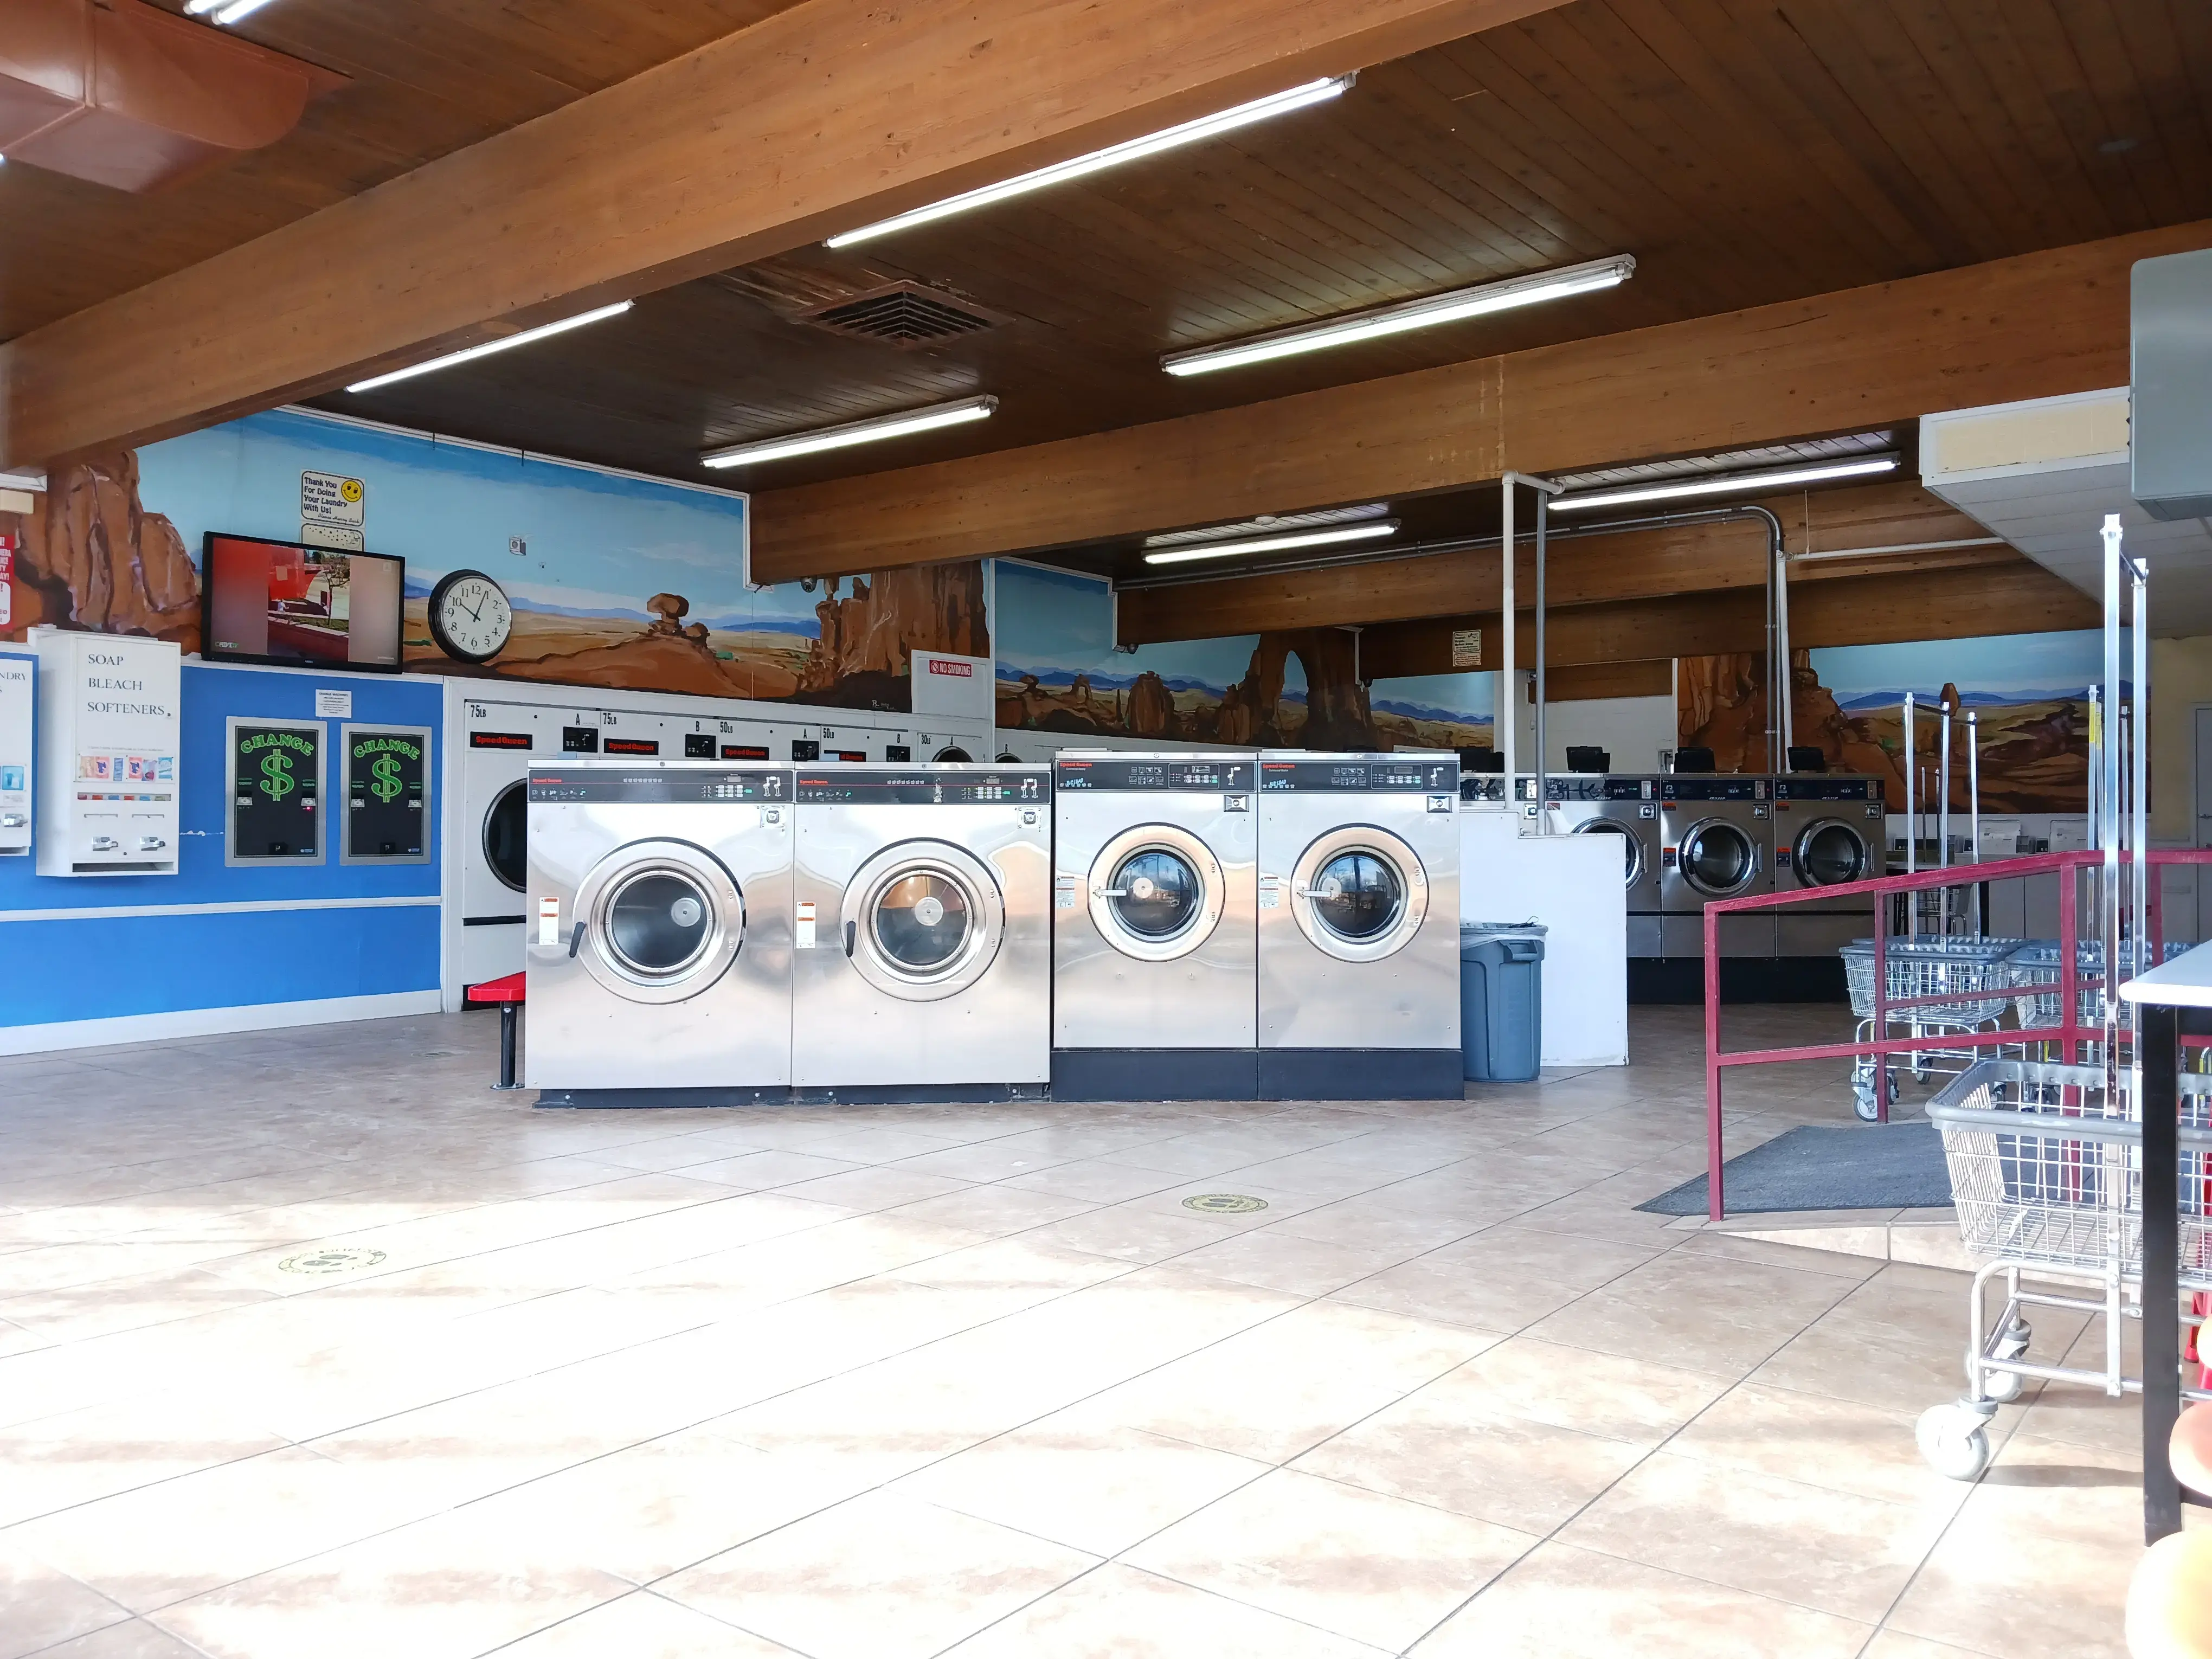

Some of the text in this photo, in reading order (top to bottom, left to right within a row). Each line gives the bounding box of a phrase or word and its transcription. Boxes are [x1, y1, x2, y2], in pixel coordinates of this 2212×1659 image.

[304, 477, 337, 488] Thank You
[317, 488, 336, 497] Doing
[304, 494, 347, 507] Your Laundry
[304, 503, 319, 512] With
[461, 587, 468, 597] 11
[472, 585, 481, 595] 12
[453, 597, 461, 607] 10
[493, 600, 498, 609] 2
[448, 608, 454, 618] 9
[497, 614, 502, 623] 3
[451, 622, 458, 631] 8
[492, 627, 498, 635] 4
[461, 633, 466, 642] 7
[471, 637, 478, 647] 6
[484, 635, 490, 645] 5
[88, 654, 124, 665] SOAP
[940, 663, 970, 675] NO SMOKING
[89, 678, 142, 690] BLEACH
[471, 705, 486, 717] 75LB
[576, 713, 580, 725] A
[603, 713, 616, 725] 75LB
[696, 721, 700, 731] B
[720, 722, 733, 733] 50LB
[803, 728, 807, 738] A
[823, 728, 834, 738] 50LB
[476, 736, 528, 745] Speed Queen
[897, 734, 901, 743] B
[921, 735, 930, 744] 30LB
[950, 736, 953, 745] A
[241, 734, 314, 756] CHANGE
[354, 738, 420, 760] CHANGE
[1005, 743, 1008, 752] B
